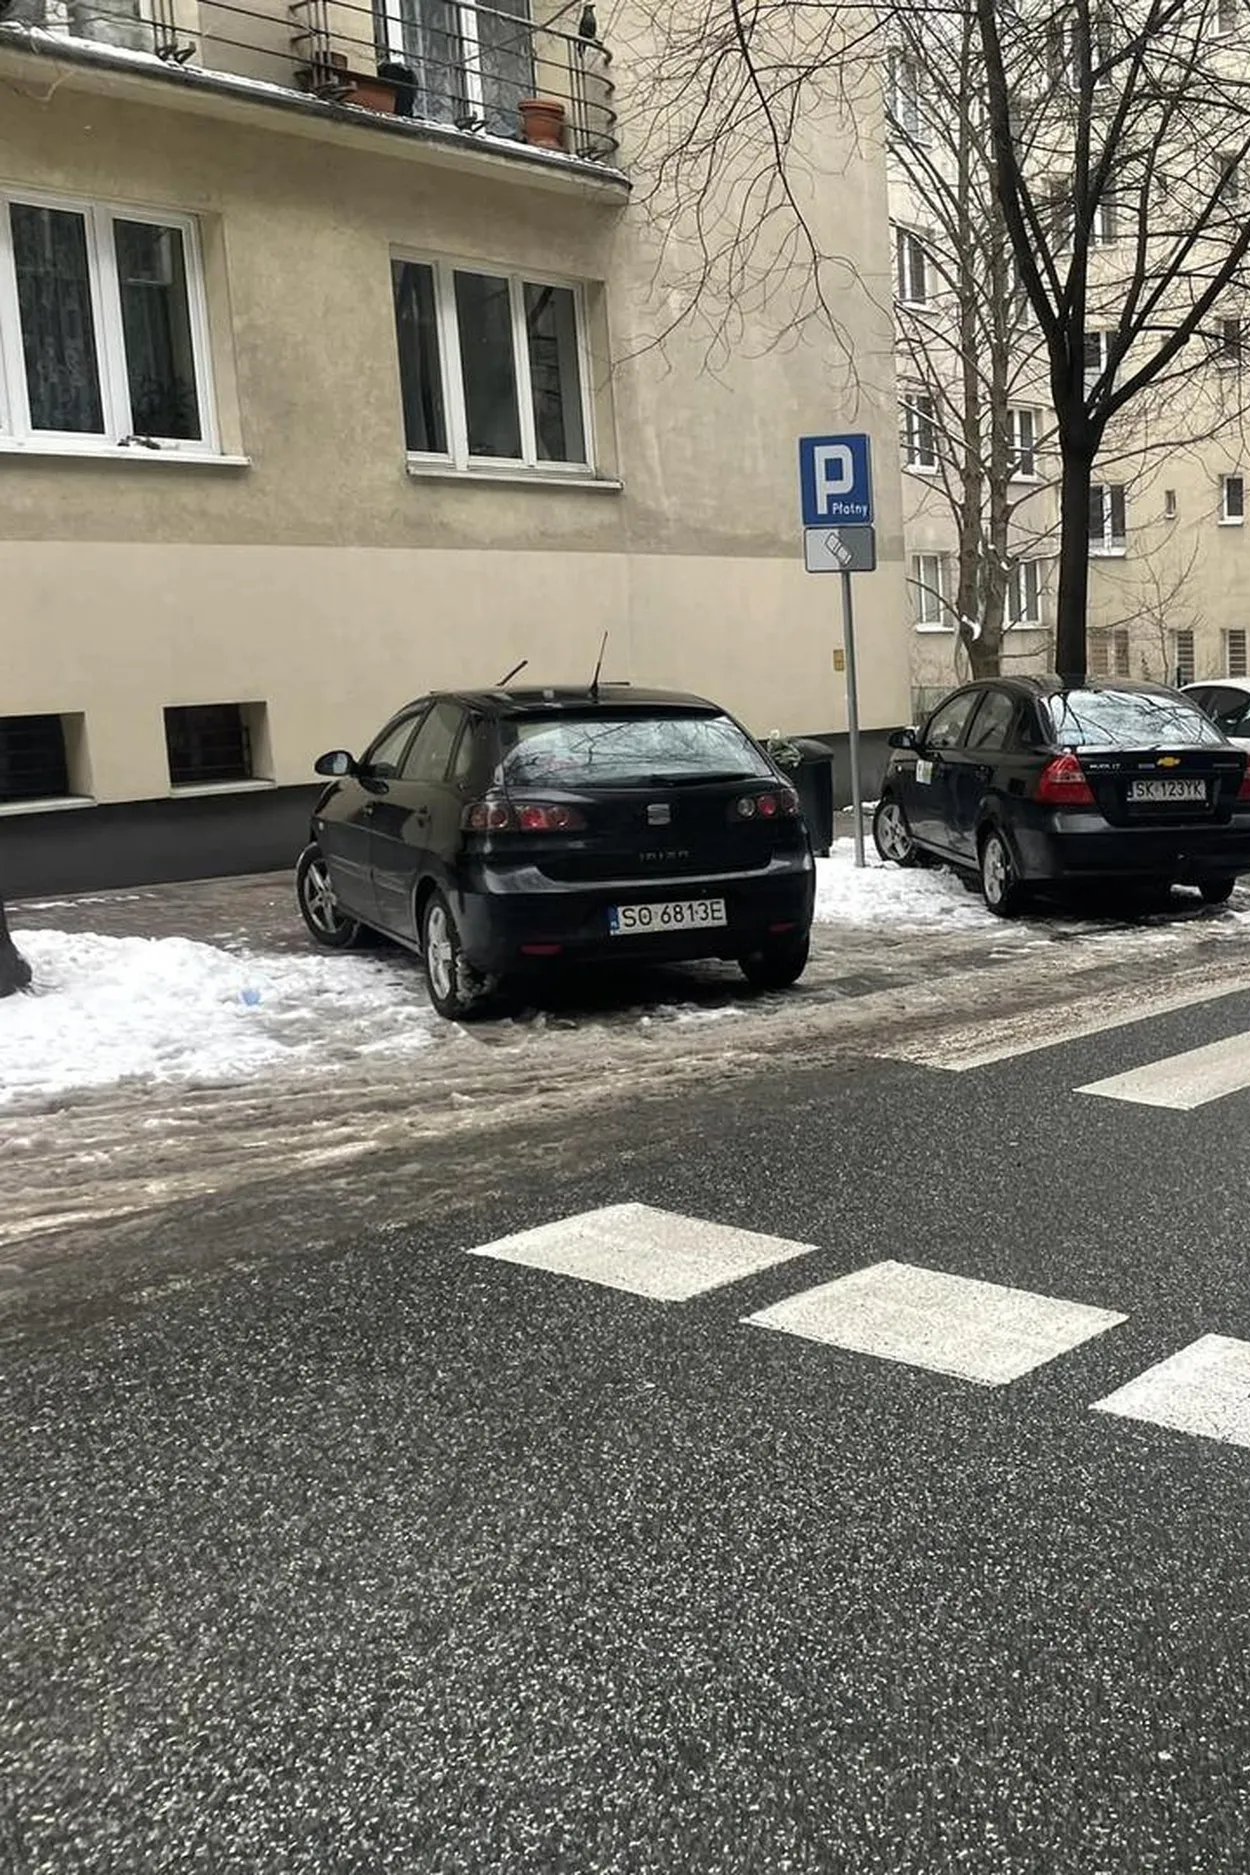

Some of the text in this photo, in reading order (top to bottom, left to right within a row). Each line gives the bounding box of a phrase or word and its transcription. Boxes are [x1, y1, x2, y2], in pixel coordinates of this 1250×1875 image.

[814, 444, 853, 515] P
[1136, 780, 1201, 797] SK 123YK
[621, 901, 722, 928] SO 6813E
